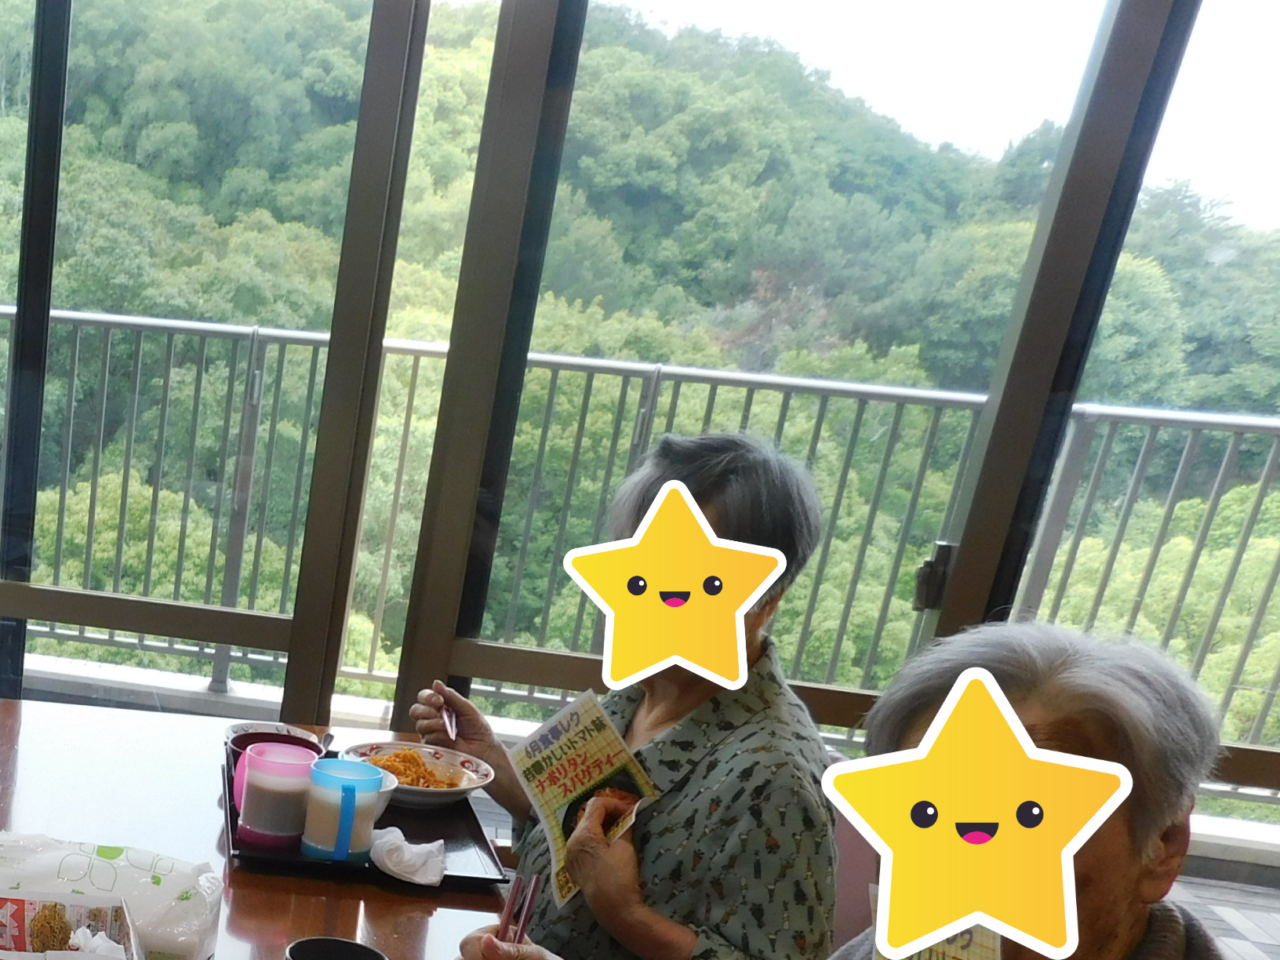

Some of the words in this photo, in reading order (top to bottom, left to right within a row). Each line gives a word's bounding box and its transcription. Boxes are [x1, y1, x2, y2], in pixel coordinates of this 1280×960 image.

[525, 711, 580, 758] 6月食事レク
[536, 750, 586, 794] ナポリタン
